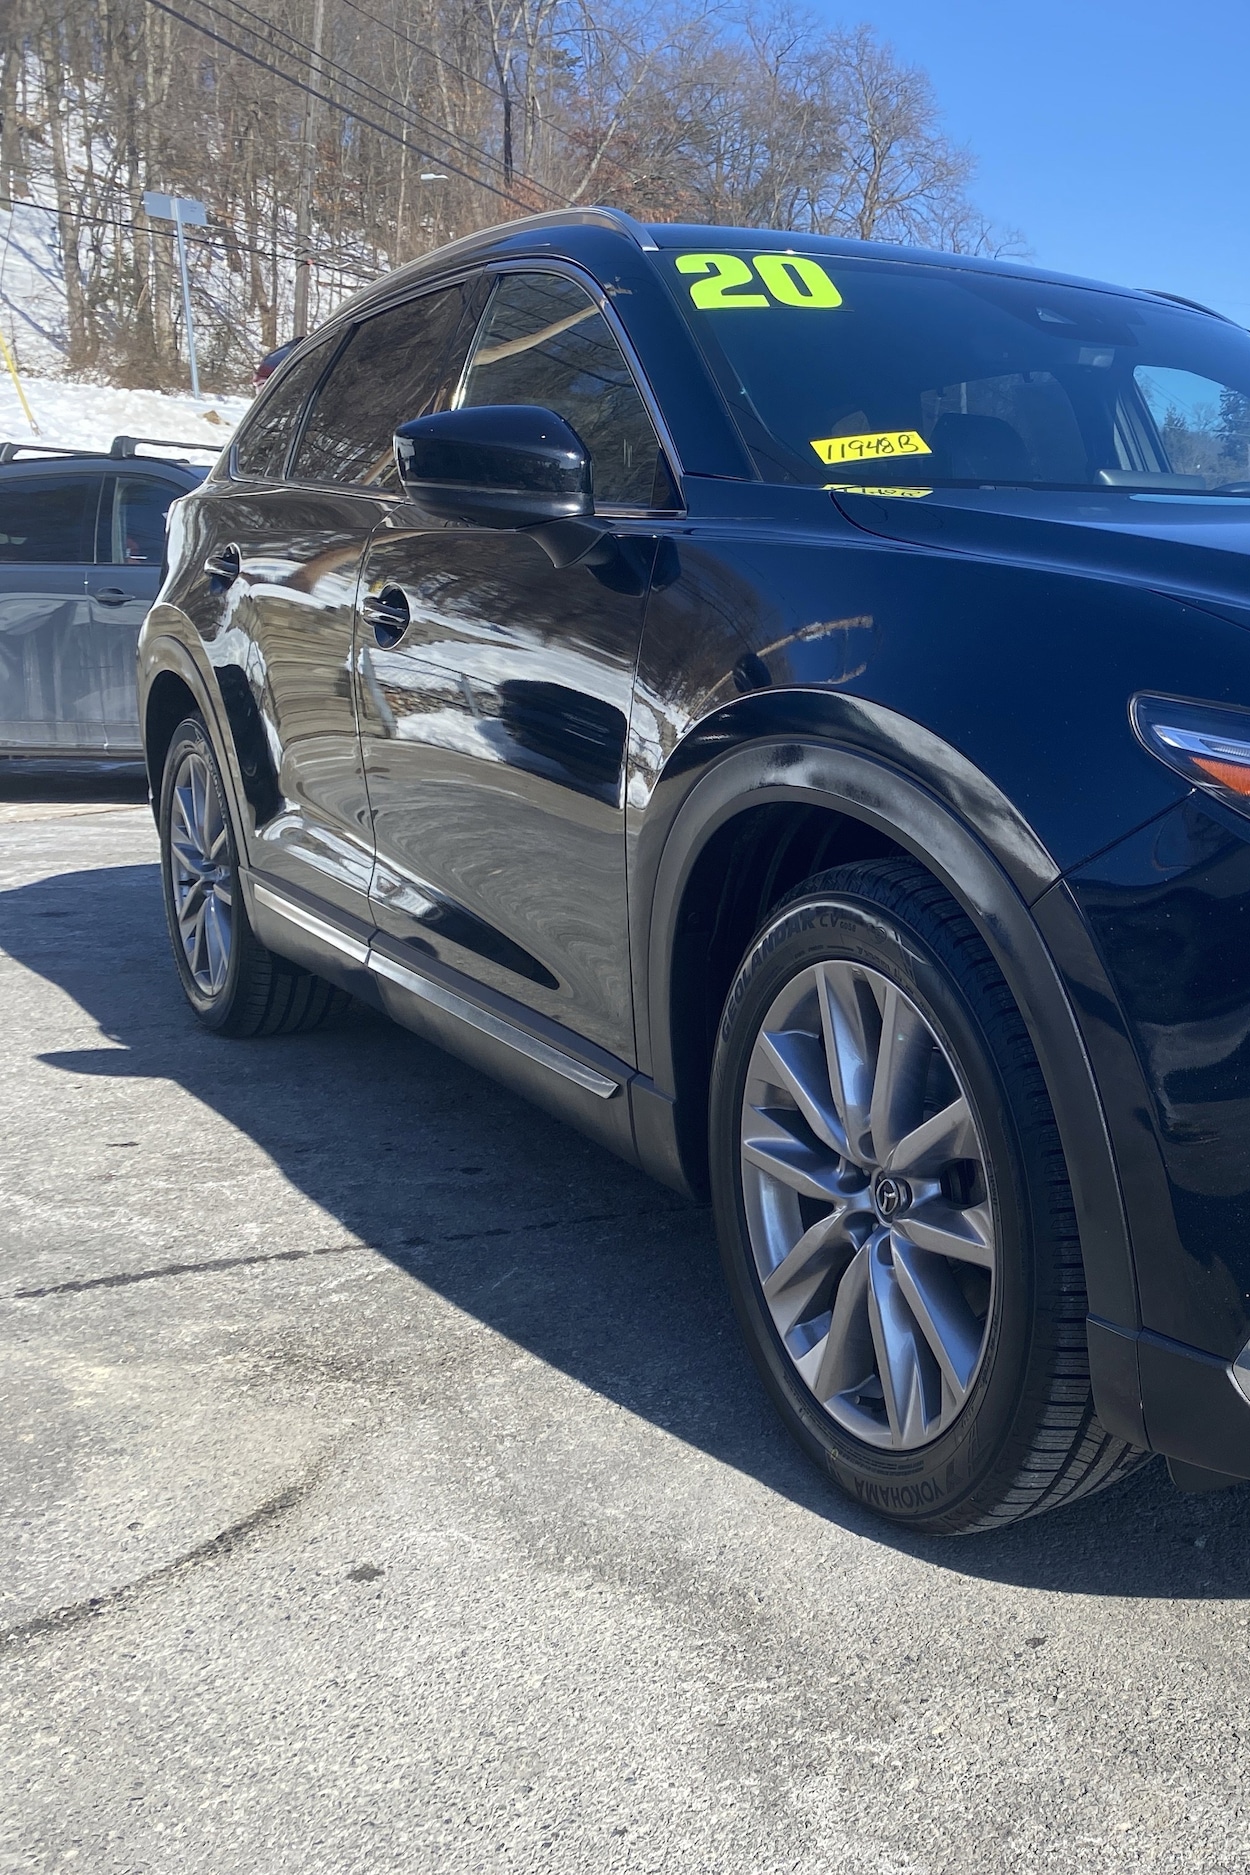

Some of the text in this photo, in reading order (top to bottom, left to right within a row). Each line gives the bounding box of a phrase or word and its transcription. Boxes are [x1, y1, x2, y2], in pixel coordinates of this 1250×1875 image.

[675, 254, 843, 309] 20
[720, 906, 818, 1042] GEOLANDAR
[819, 912, 840, 928] CV
[854, 1476, 944, 1509] YOKOHAMA
